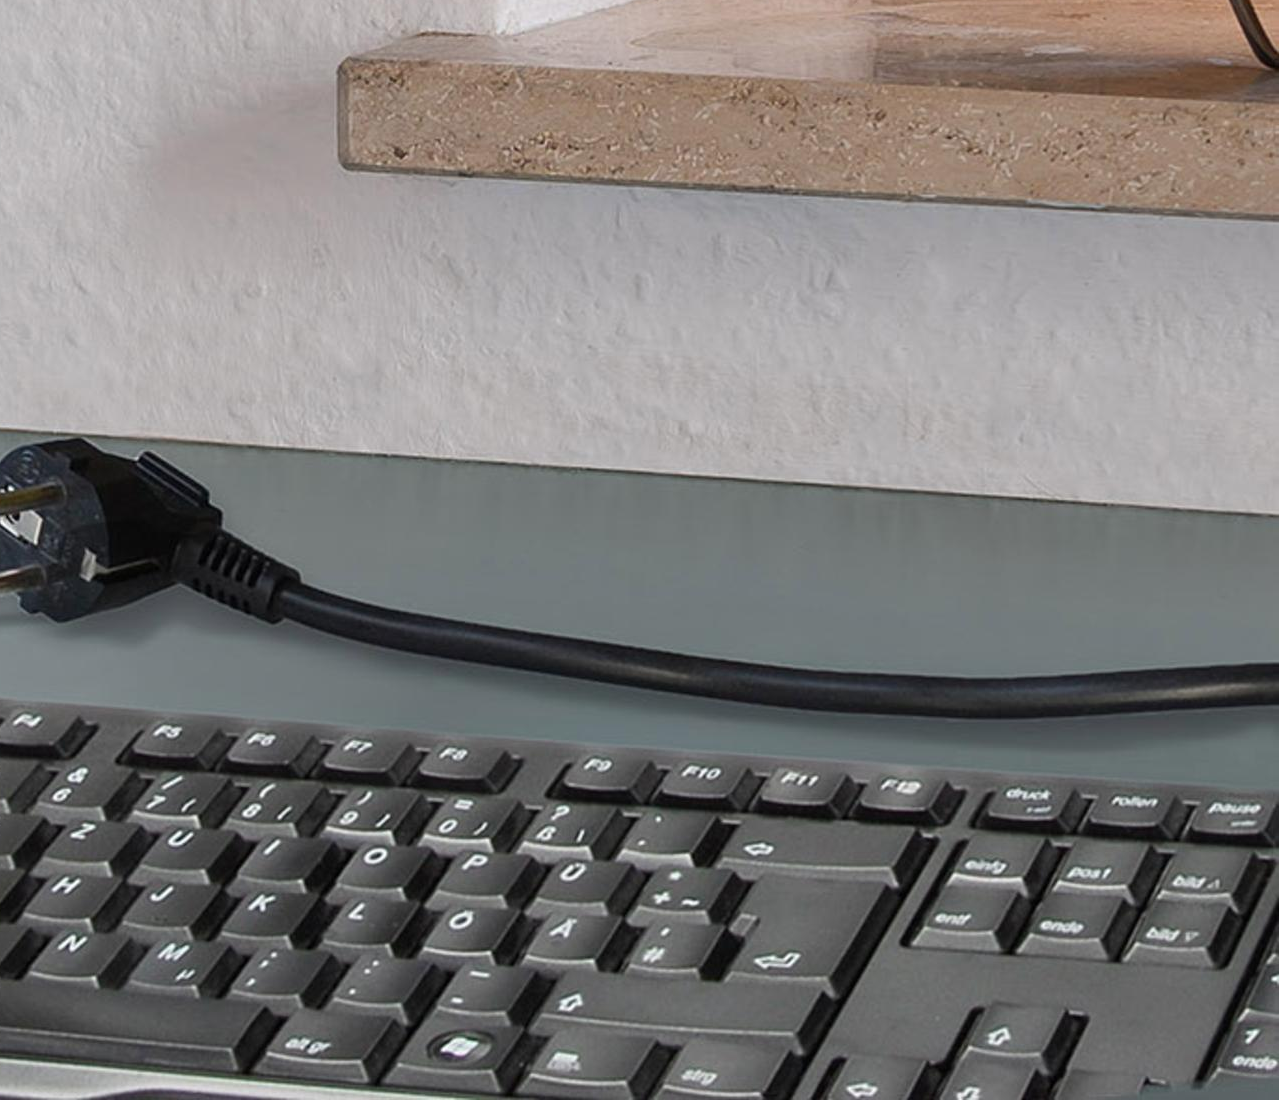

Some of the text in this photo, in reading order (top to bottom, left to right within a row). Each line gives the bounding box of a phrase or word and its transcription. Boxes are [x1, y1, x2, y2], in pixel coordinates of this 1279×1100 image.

[152, 724, 183, 739] F5
[246, 732, 276, 747] F6
[343, 739, 373, 754] F7
[439, 747, 468, 761] F8
[583, 758, 612, 772] F9
[681, 765, 722, 780] F10
[780, 771, 819, 787] F11
[51, 787, 72, 802] 6
[145, 794, 167, 810] 7
[1005, 787, 1051, 801] druck
[241, 803, 262, 818] 8
[1207, 802, 1262, 814] pause
[339, 810, 359, 826] 9
[70, 822, 96, 840] Z
[167, 830, 194, 847] U
[363, 847, 388, 865] O
[461, 854, 490, 872] P
[965, 860, 1008, 875] einfg
[51, 876, 81, 894] H
[1171, 875, 1205, 890] bild
[150, 885, 174, 902] J
[247, 894, 276, 912] K
[347, 902, 366, 920] L
[934, 913, 972, 926] entf
[1039, 918, 1084, 933] ende
[1145, 926, 1180, 942] bild
[57, 934, 88, 953] N
[157, 942, 190, 961] M
[1232, 1055, 1279, 1071] ende
